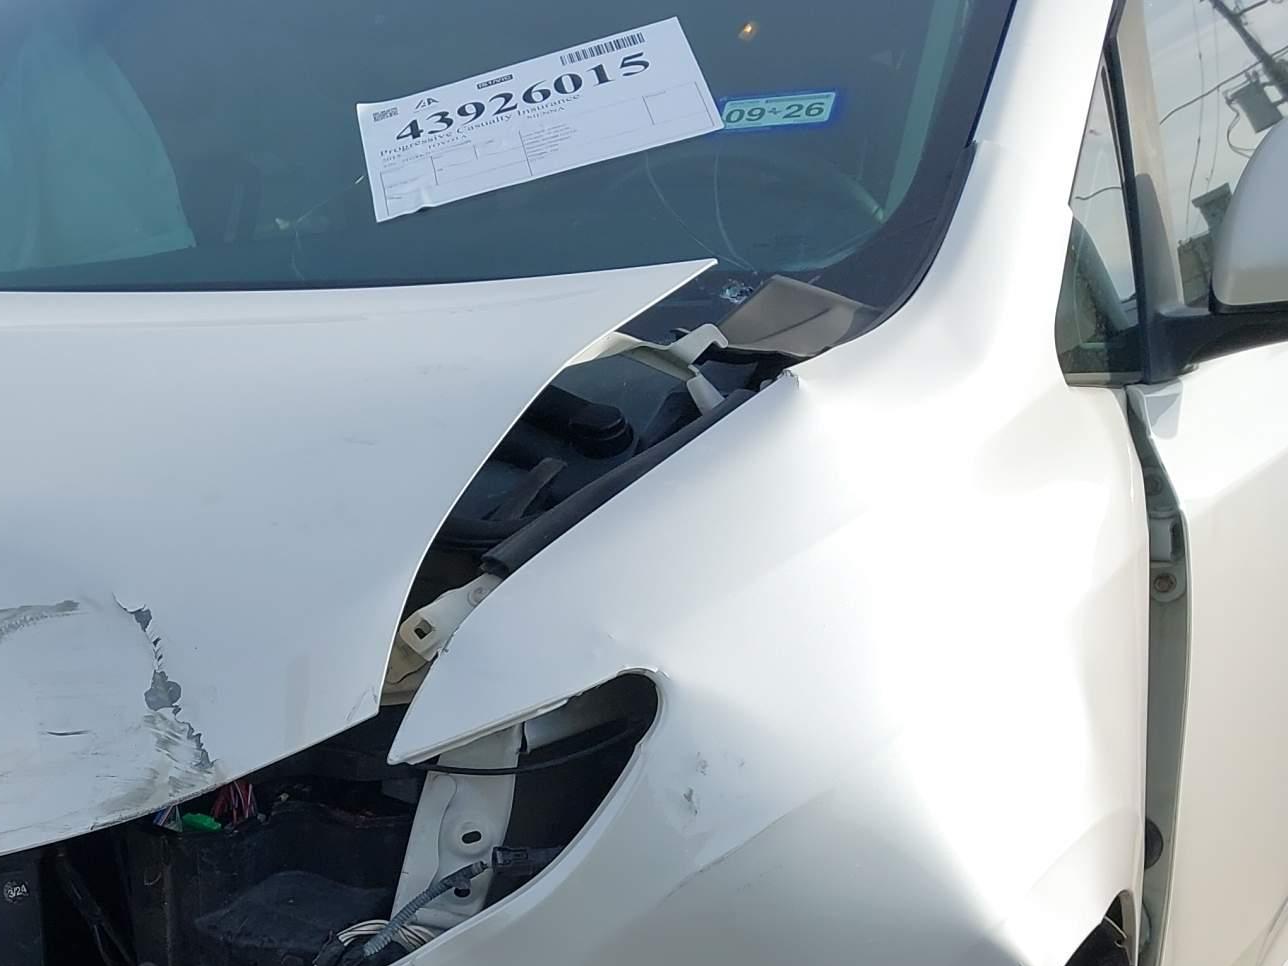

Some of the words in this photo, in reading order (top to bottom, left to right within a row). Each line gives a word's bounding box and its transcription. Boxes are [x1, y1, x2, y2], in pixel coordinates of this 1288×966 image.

[379, 131, 455, 157] Progressive
[456, 113, 514, 134] Casualty
[516, 93, 581, 117] Insurance
[395, 51, 651, 142] 43926015
[725, 107, 766, 123] 09
[783, 102, 825, 119] 26
